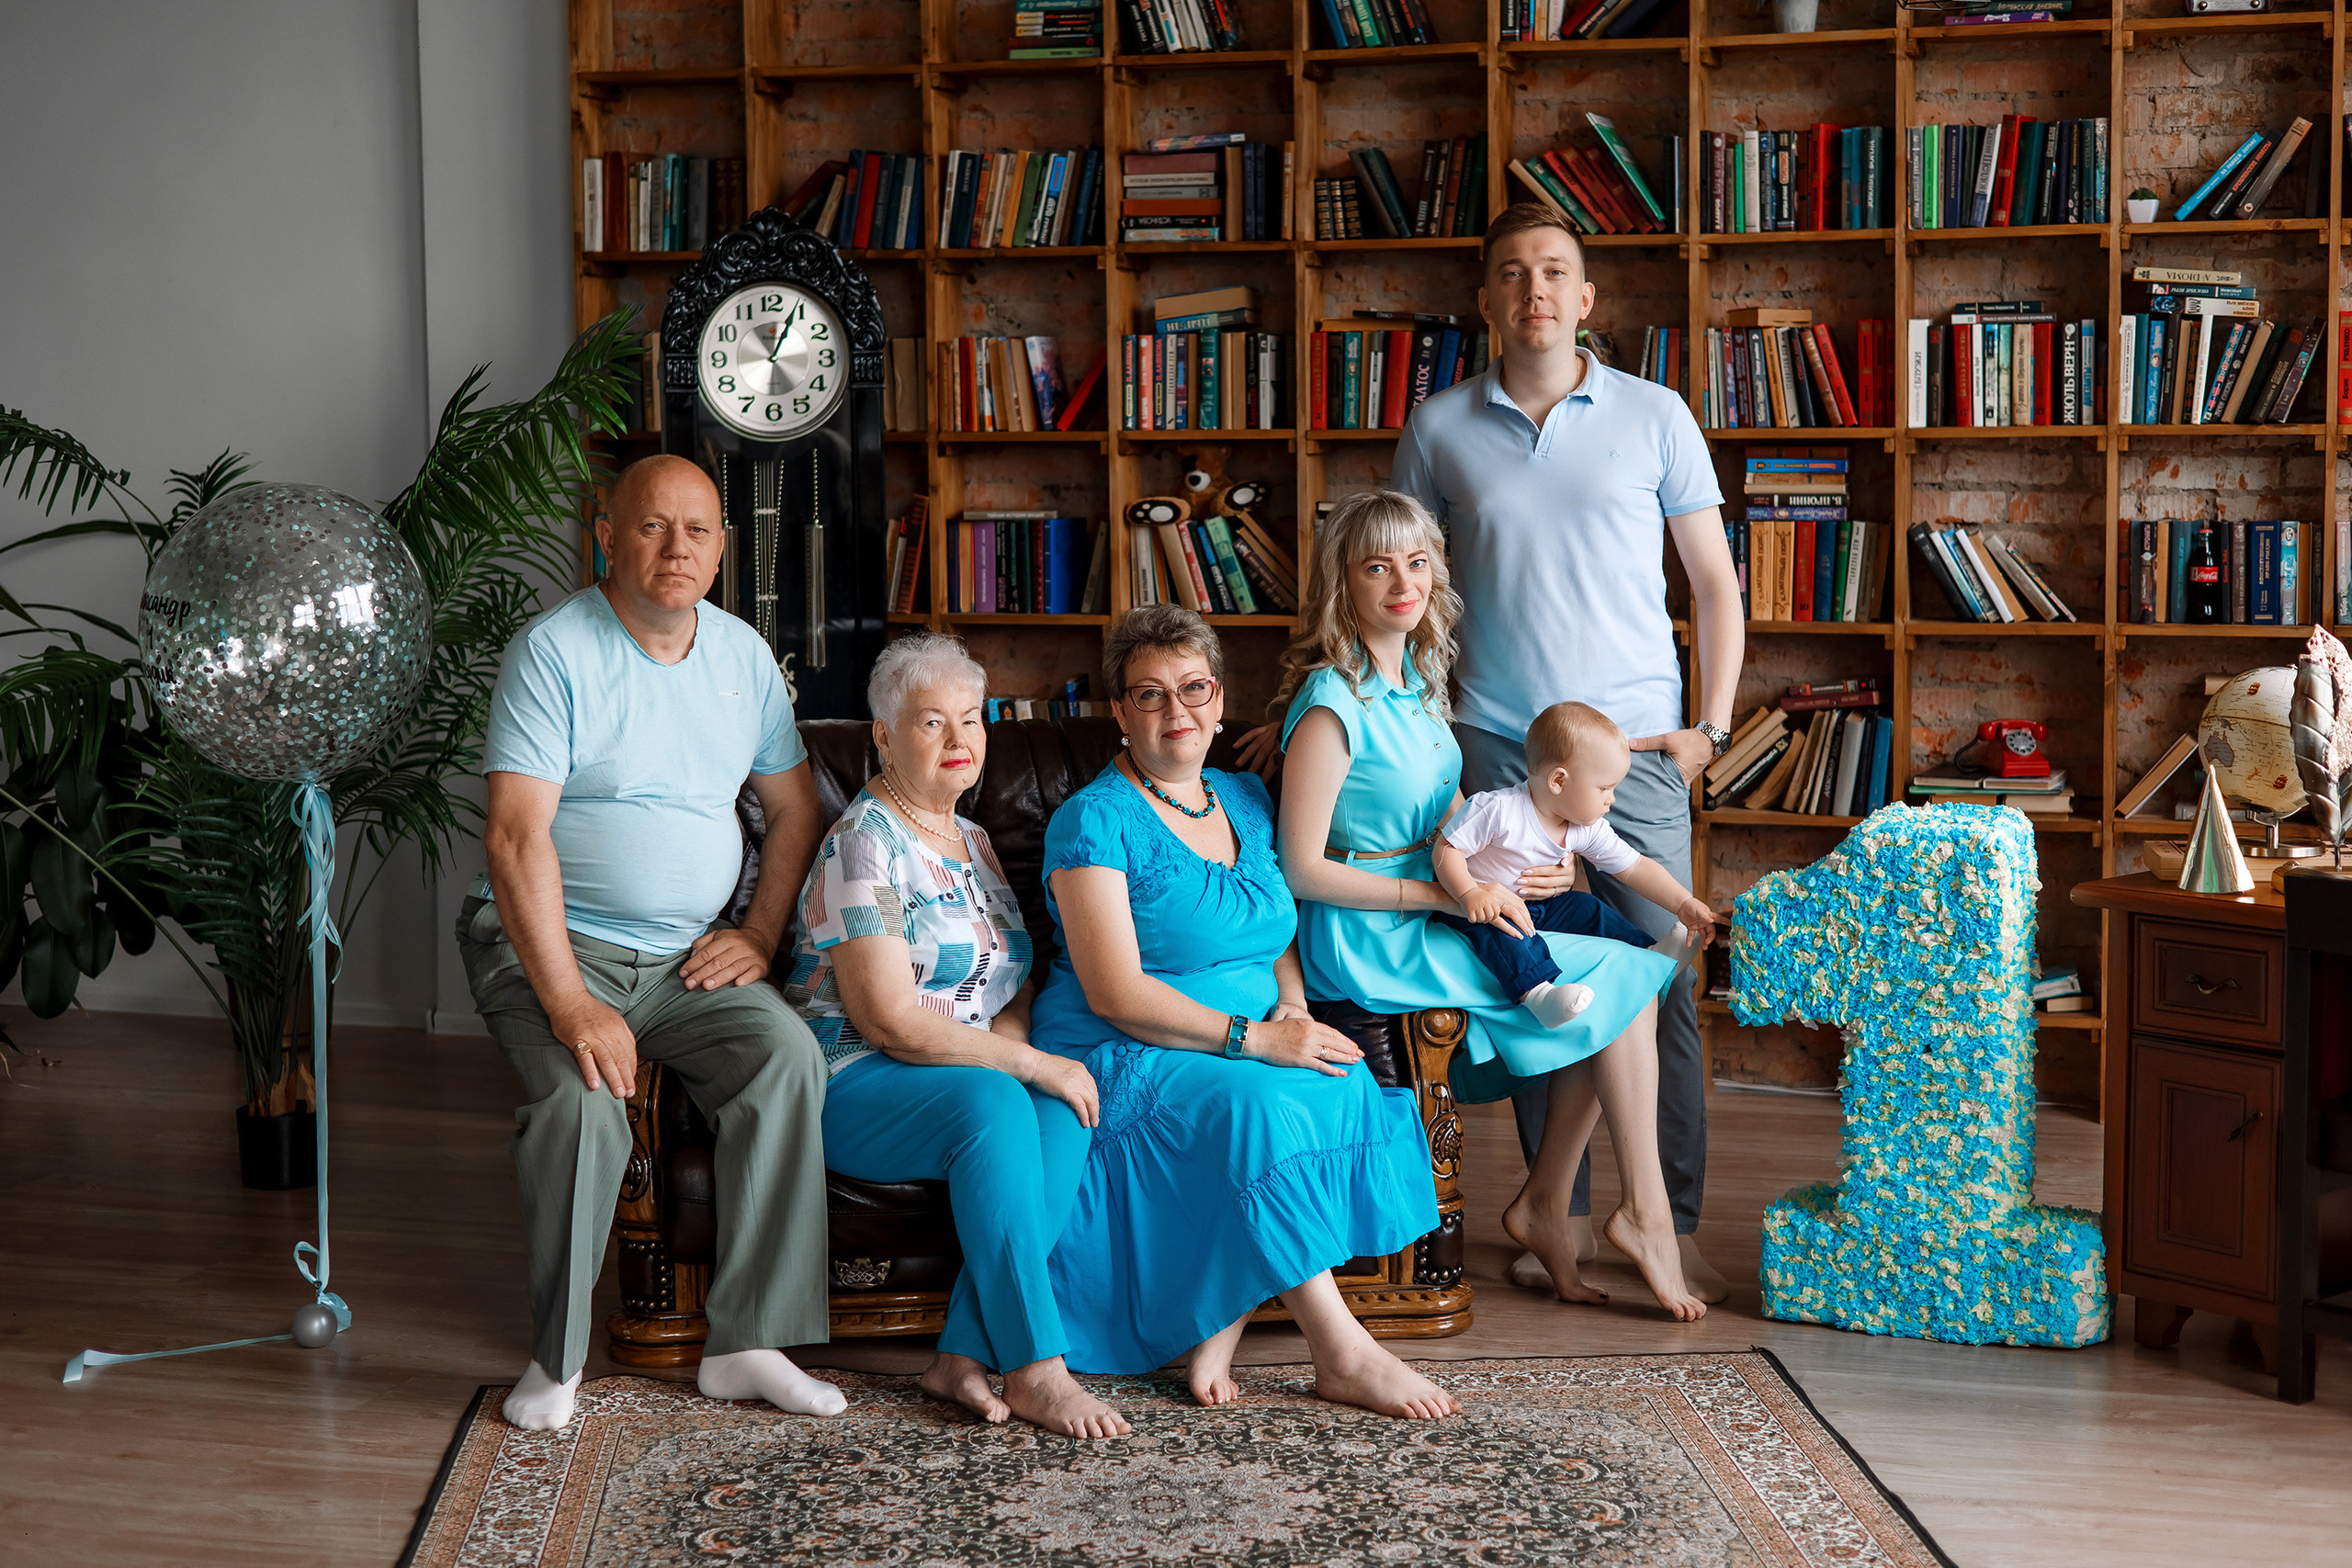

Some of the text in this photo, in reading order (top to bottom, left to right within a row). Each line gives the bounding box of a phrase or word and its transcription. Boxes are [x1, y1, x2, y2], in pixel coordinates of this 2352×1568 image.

[2166, 271, 2200, 282] ДЮМА
[735, 303, 753, 321] 11
[761, 294, 784, 313] 12
[798, 302, 805, 321] 1
[718, 323, 738, 343] 10
[810, 323, 829, 341] 2
[711, 351, 728, 368] 9
[818, 349, 836, 367] 3
[2165, 360, 2172, 369] НА
[1914, 351, 1922, 385] БЛУЗКИ
[718, 375, 736, 393] 8
[809, 375, 828, 392] 4
[2063, 340, 2075, 424] ЖЮЛЬ ВЕРН
[738, 395, 755, 413] 7
[764, 402, 784, 422] 6
[793, 395, 810, 414] 5
[1789, 495, 1842, 506] В. ПРОНИН
